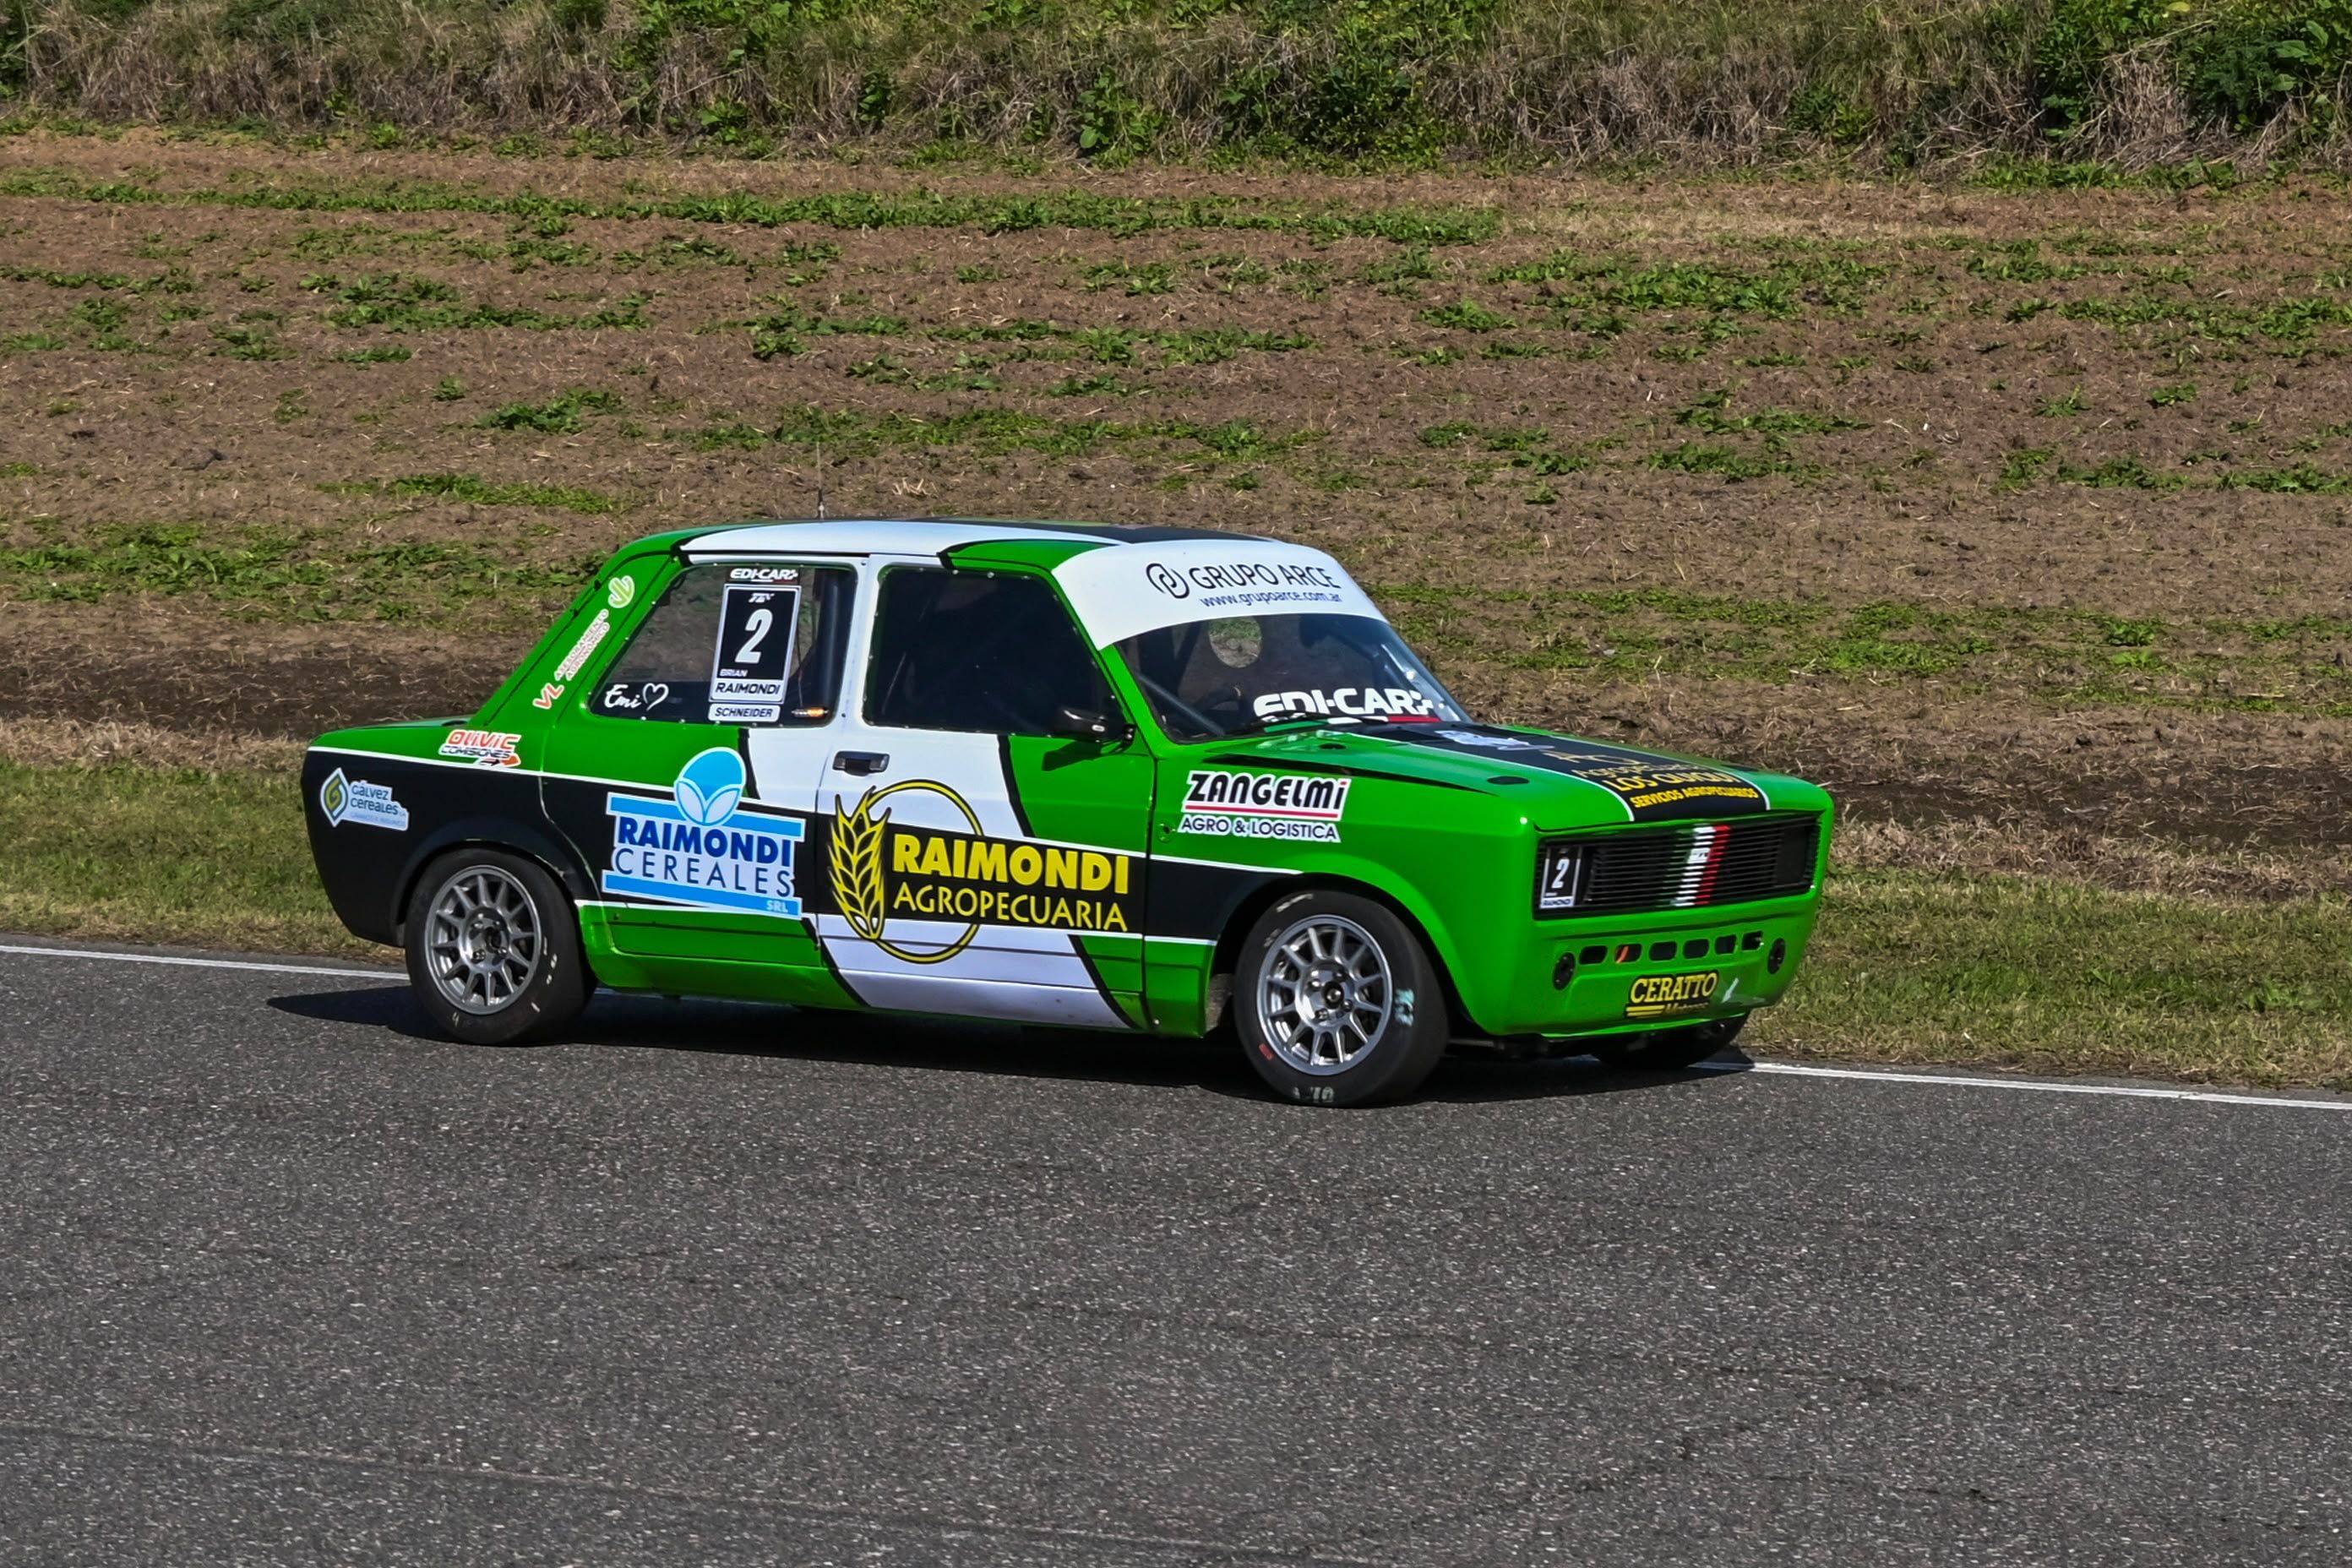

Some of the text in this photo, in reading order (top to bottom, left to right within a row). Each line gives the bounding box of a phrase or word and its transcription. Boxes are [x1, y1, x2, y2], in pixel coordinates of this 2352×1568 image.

[1189, 564, 1342, 589] GRUPO ARCE
[734, 608, 773, 664] 2
[720, 668, 748, 677] BRIAN
[534, 685, 564, 707] VL
[604, 683, 642, 708] Emi
[716, 683, 781, 694] RAIMONDI
[715, 707, 773, 717] SCHNEIDER
[1602, 776, 1658, 792] LOS
[1630, 787, 1684, 808] SERVICIOS
[618, 816, 792, 867] RAIMONDI
[1183, 818, 1337, 840] AGRO & LOGISTICA
[615, 848, 792, 897] CEREALES
[893, 833, 1129, 895] RAIMONDI
[1551, 858, 1570, 889] 2
[766, 901, 788, 913] SRL
[893, 881, 1128, 932] AGROPECUARIA
[1631, 972, 1718, 1004] CERATTO
